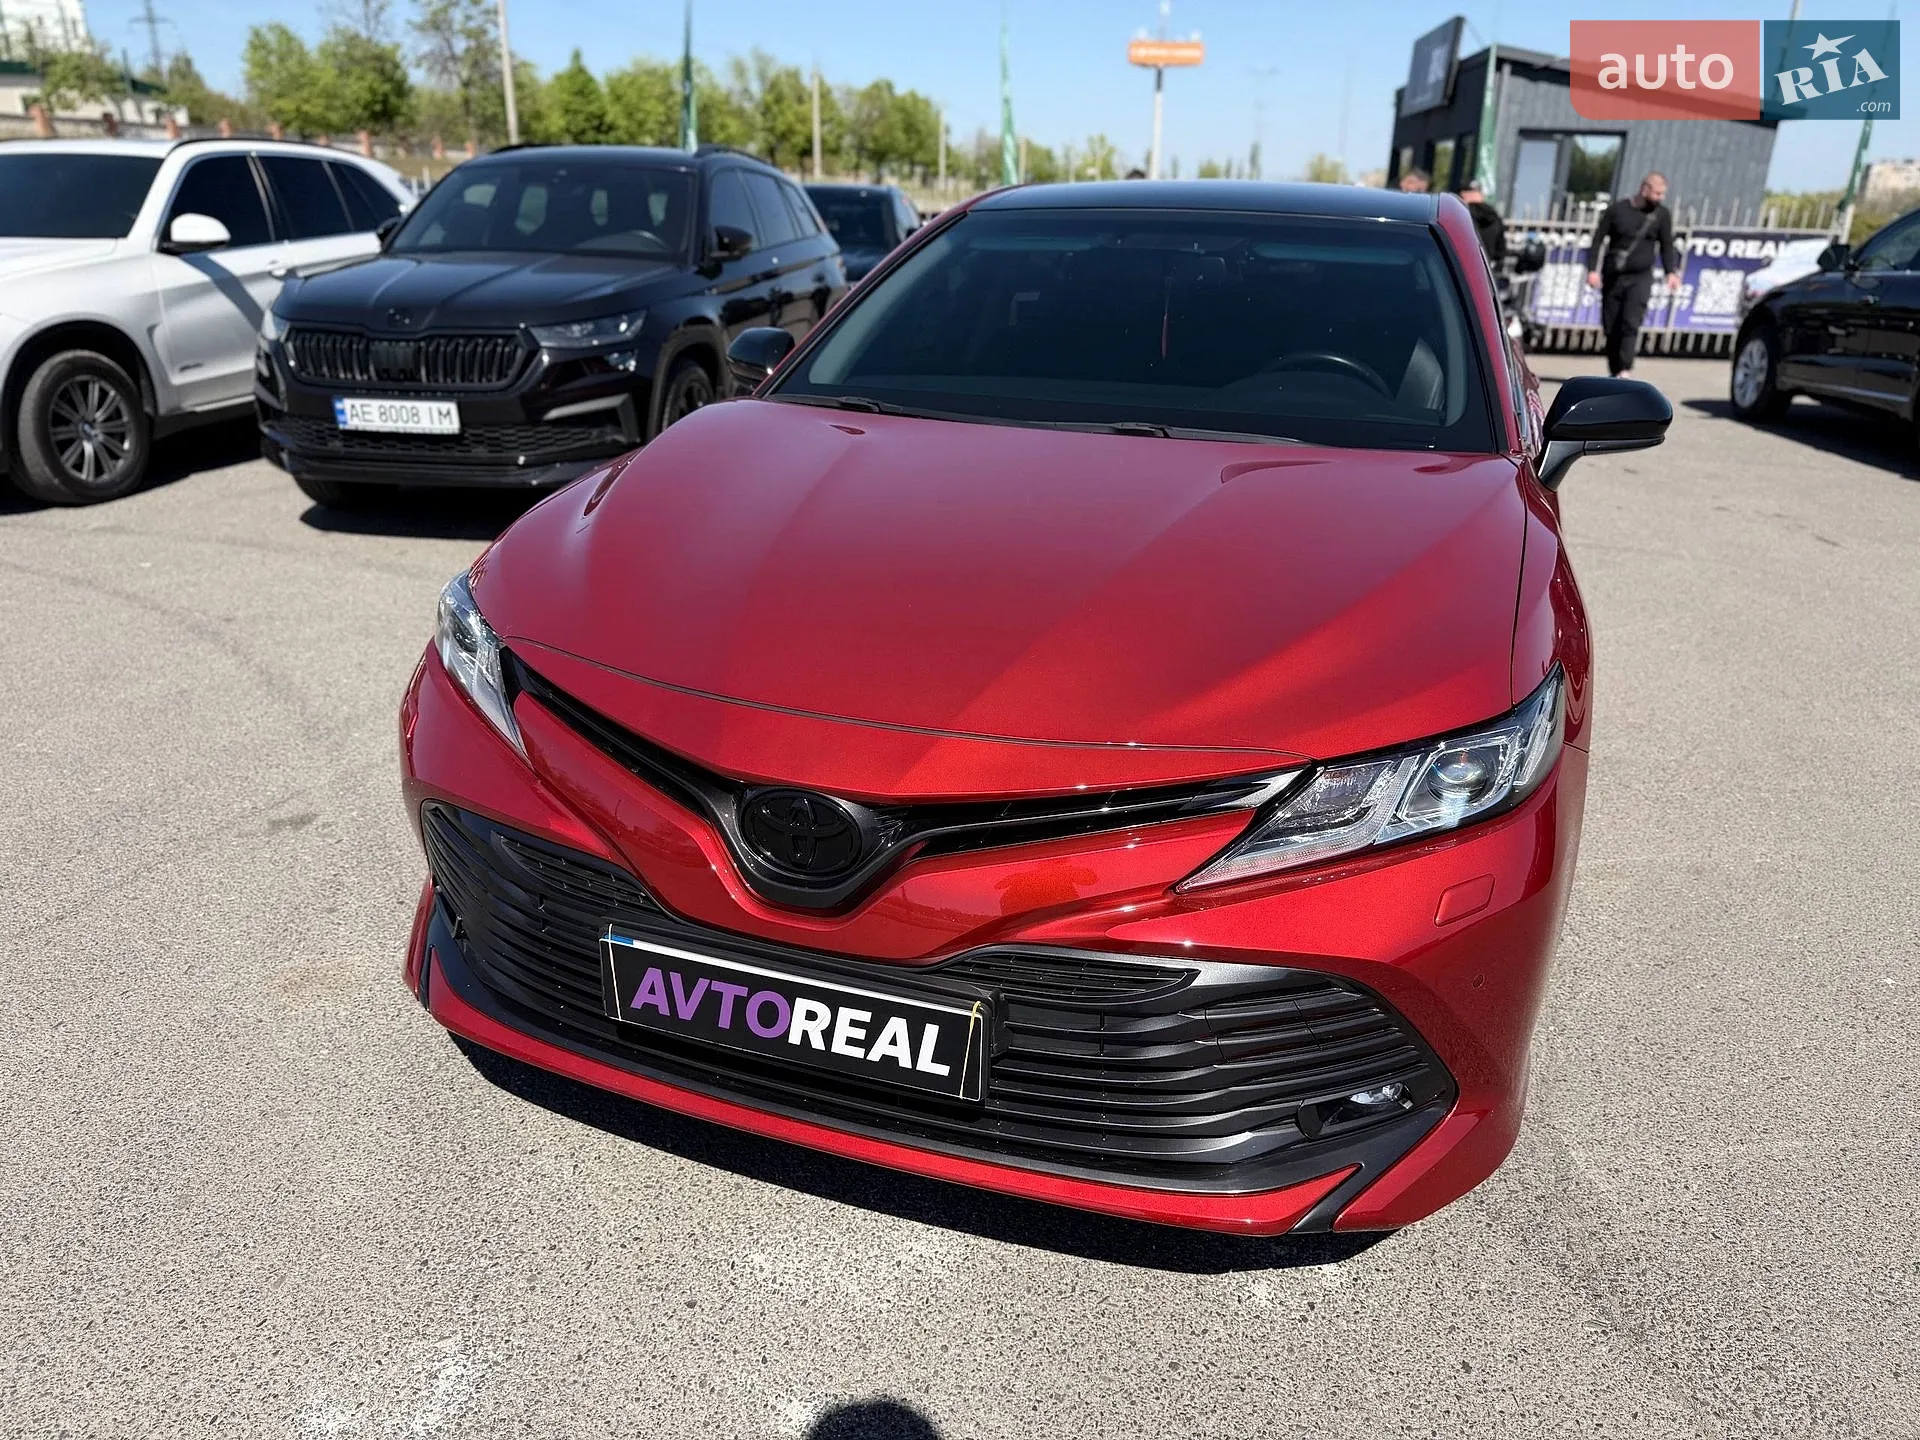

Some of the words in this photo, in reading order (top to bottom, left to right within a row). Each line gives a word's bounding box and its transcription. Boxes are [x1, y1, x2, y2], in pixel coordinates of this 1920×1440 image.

[349, 403, 375, 423] AE
[378, 404, 421, 425] 8008
[630, 966, 950, 1077] AVTOREAL
